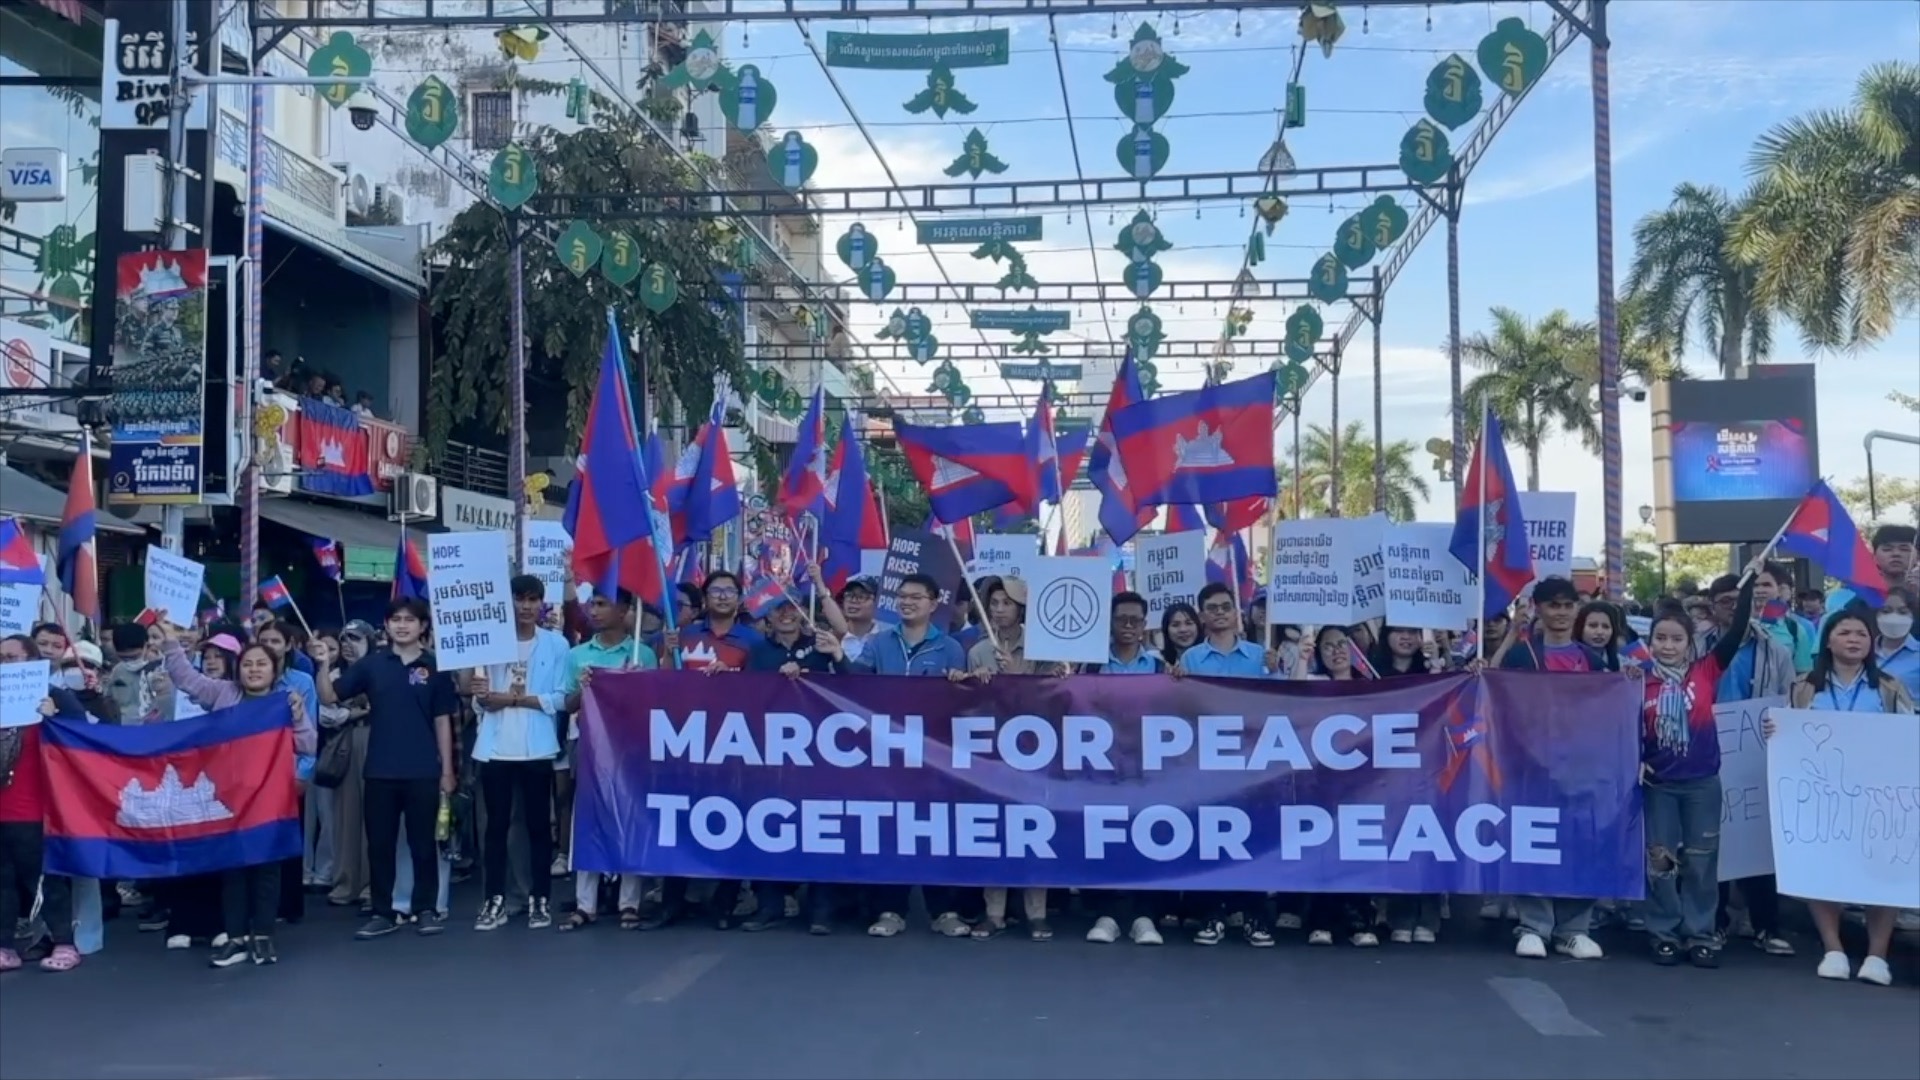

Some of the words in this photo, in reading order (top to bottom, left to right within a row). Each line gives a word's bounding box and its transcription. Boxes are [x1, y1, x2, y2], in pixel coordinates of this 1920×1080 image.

[117, 79, 171, 102] Rive
[8, 169, 52, 185] VISA
[432, 545, 461, 560] HOPE
[892, 537, 921, 557] HOPE
[1388, 543, 1430, 563] សន្តិភាព
[887, 556, 919, 576] RISES
[434, 579, 494, 605] រួមសំឡេង
[440, 631, 490, 654] សន្តិភាព
[648, 708, 925, 768] MARCH
[951, 714, 1114, 771] FOR
[1141, 712, 1422, 771] PEACE
[646, 793, 1058, 860] TOGETHER
[1083, 804, 1252, 861] FOR
[1280, 803, 1562, 865] PEACE
